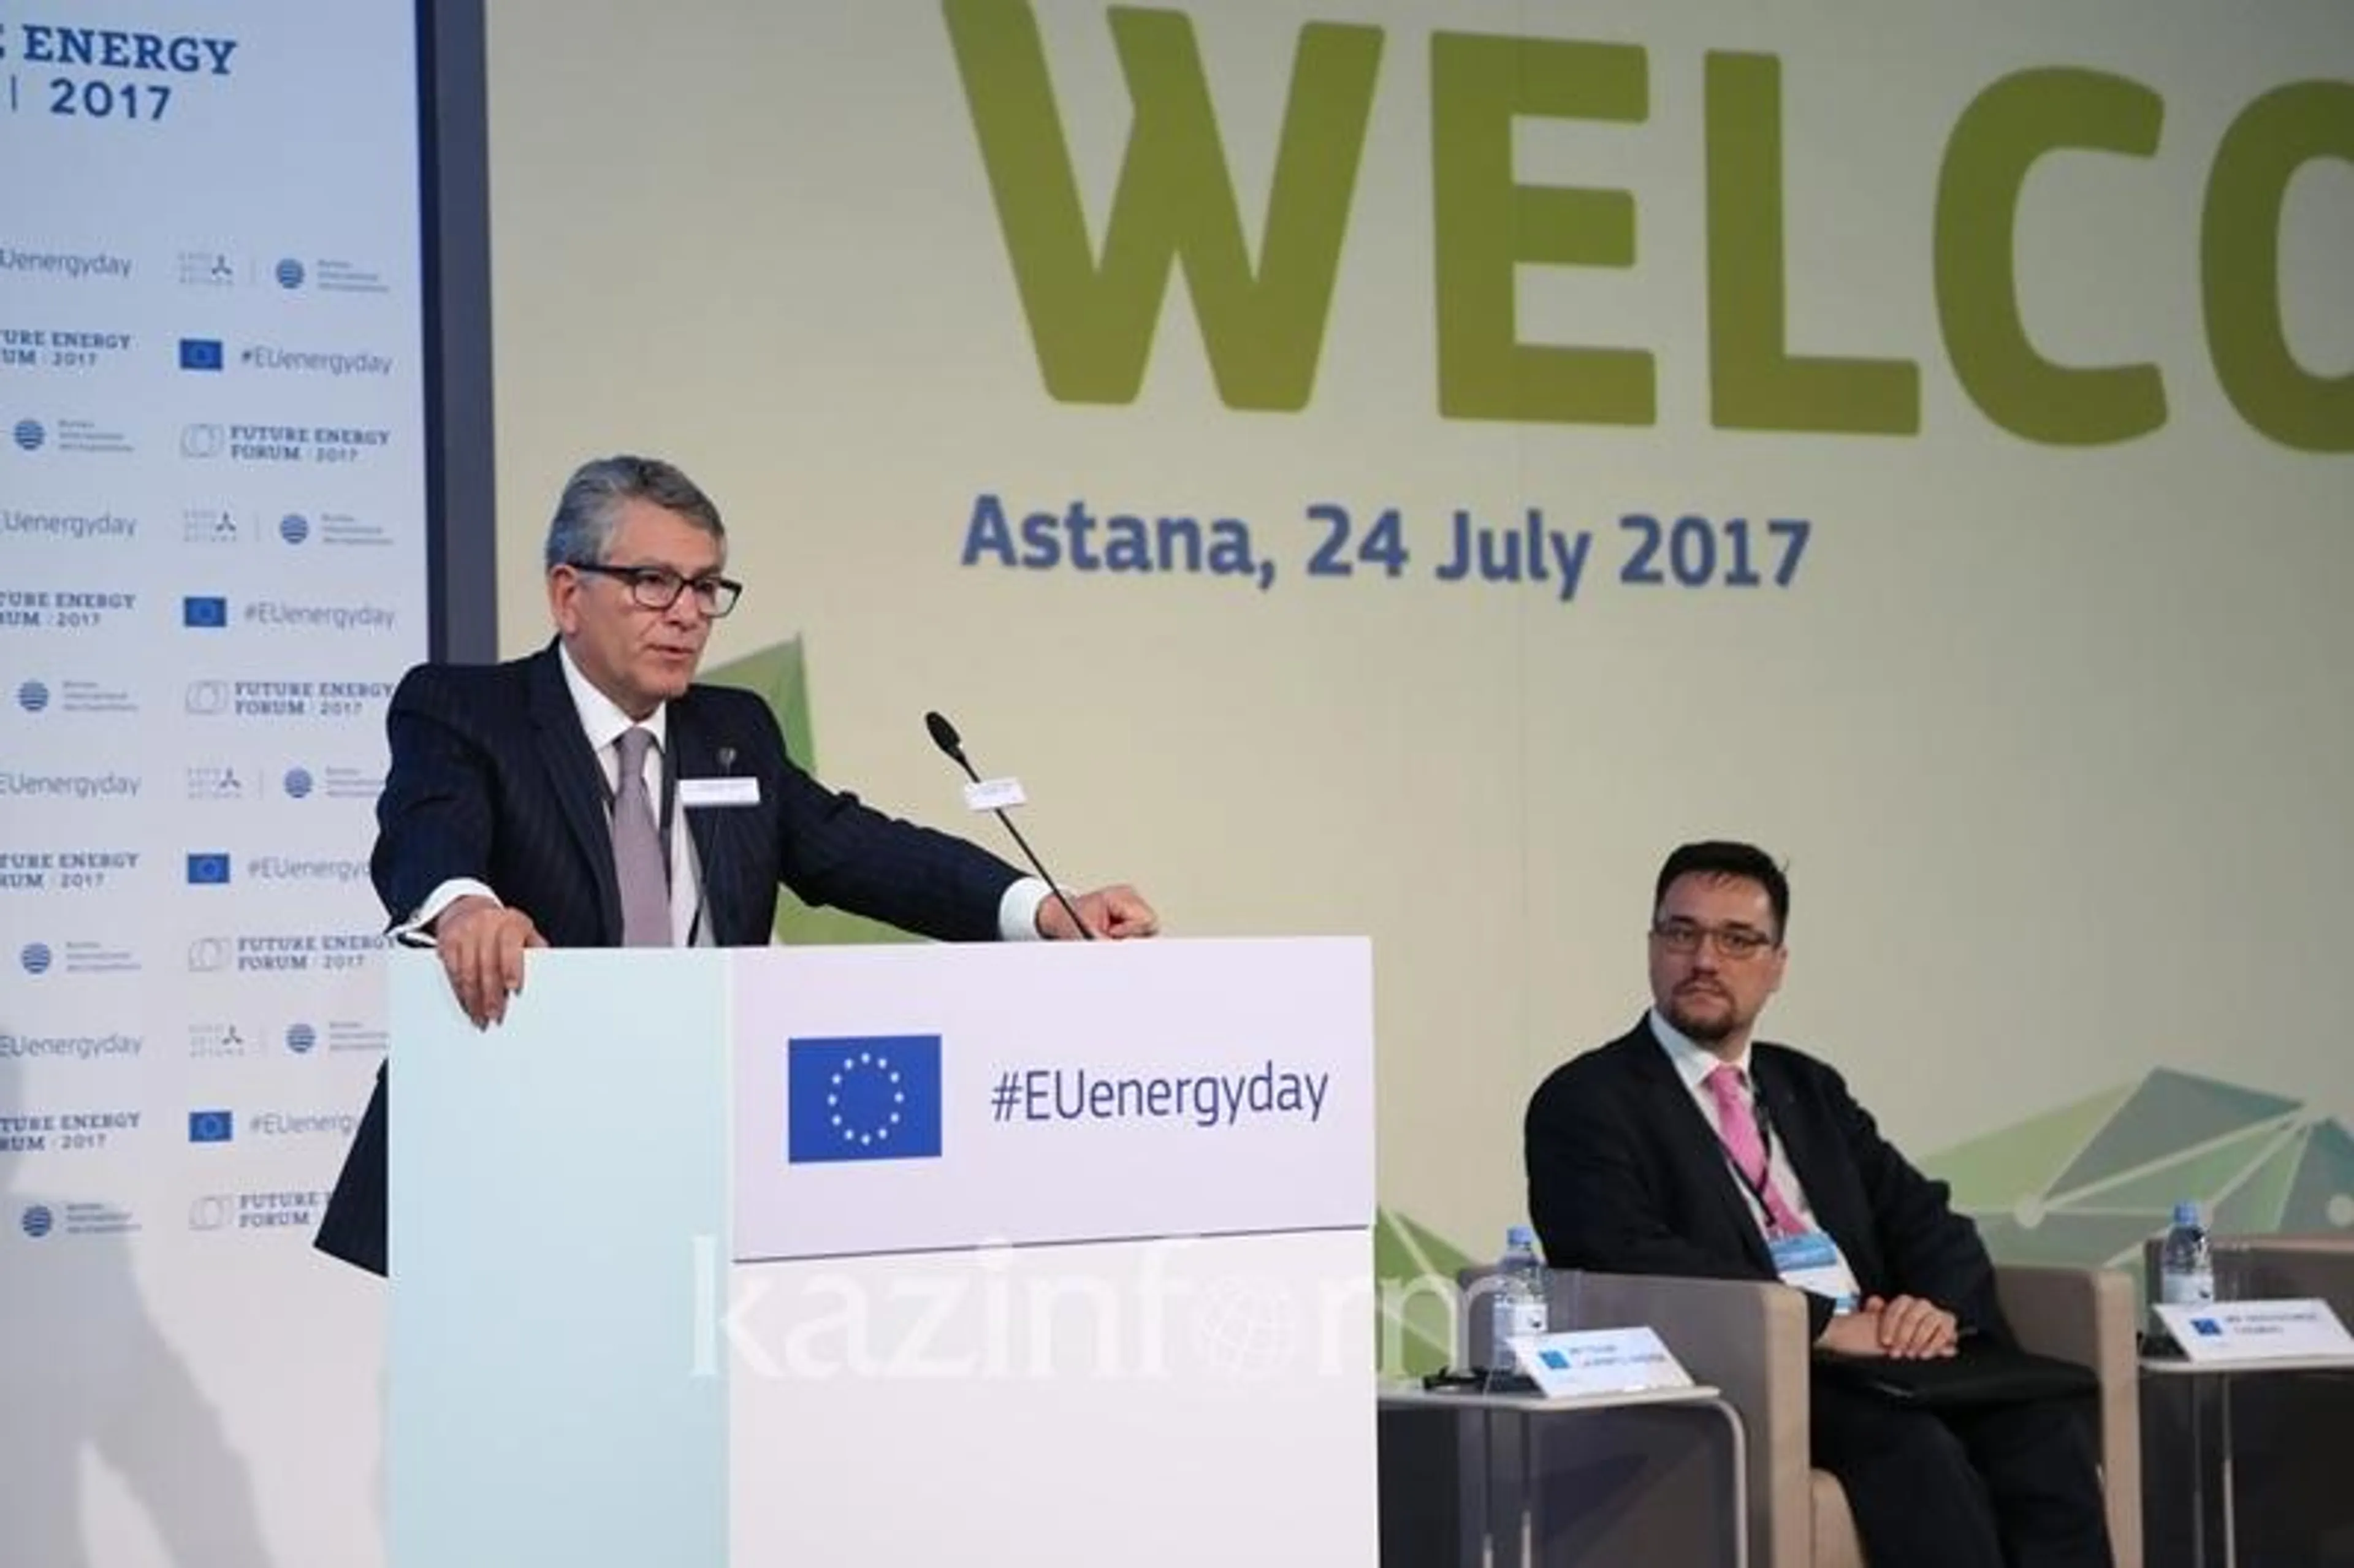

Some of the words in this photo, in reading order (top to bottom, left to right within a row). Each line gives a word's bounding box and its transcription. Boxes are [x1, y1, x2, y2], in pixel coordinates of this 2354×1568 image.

[22, 24, 239, 75] ENERGY
[50, 77, 172, 121] 2017
[940, 0, 2354, 455] WELCO
[0, 329, 45, 346] URE
[51, 331, 131, 350] ENERGY
[53, 352, 97, 366] 2017
[241, 344, 394, 376] #EUenergyday
[230, 425, 310, 443] FUTURE
[314, 427, 391, 445] ENERGY
[230, 444, 301, 460] FORUM
[961, 494, 1275, 590] Astana,
[1305, 504, 1409, 579] 24
[1434, 509, 1592, 603] July
[1618, 515, 1810, 588] 2017
[55, 592, 136, 609] ENERGY
[56, 612, 101, 628] 2017
[235, 681, 313, 698] FUTURE
[319, 682, 396, 699] ENERGY
[235, 700, 304, 715] FORUM
[59, 853, 140, 868] ENERGY
[238, 935, 316, 951] FUTURE
[238, 955, 308, 971] FORUM
[991, 1060, 1329, 1127] #EUenergyday
[61, 1111, 141, 1132] ENERGY
[239, 1192, 319, 1209] FUTURE
[239, 1211, 310, 1227] FORUM
